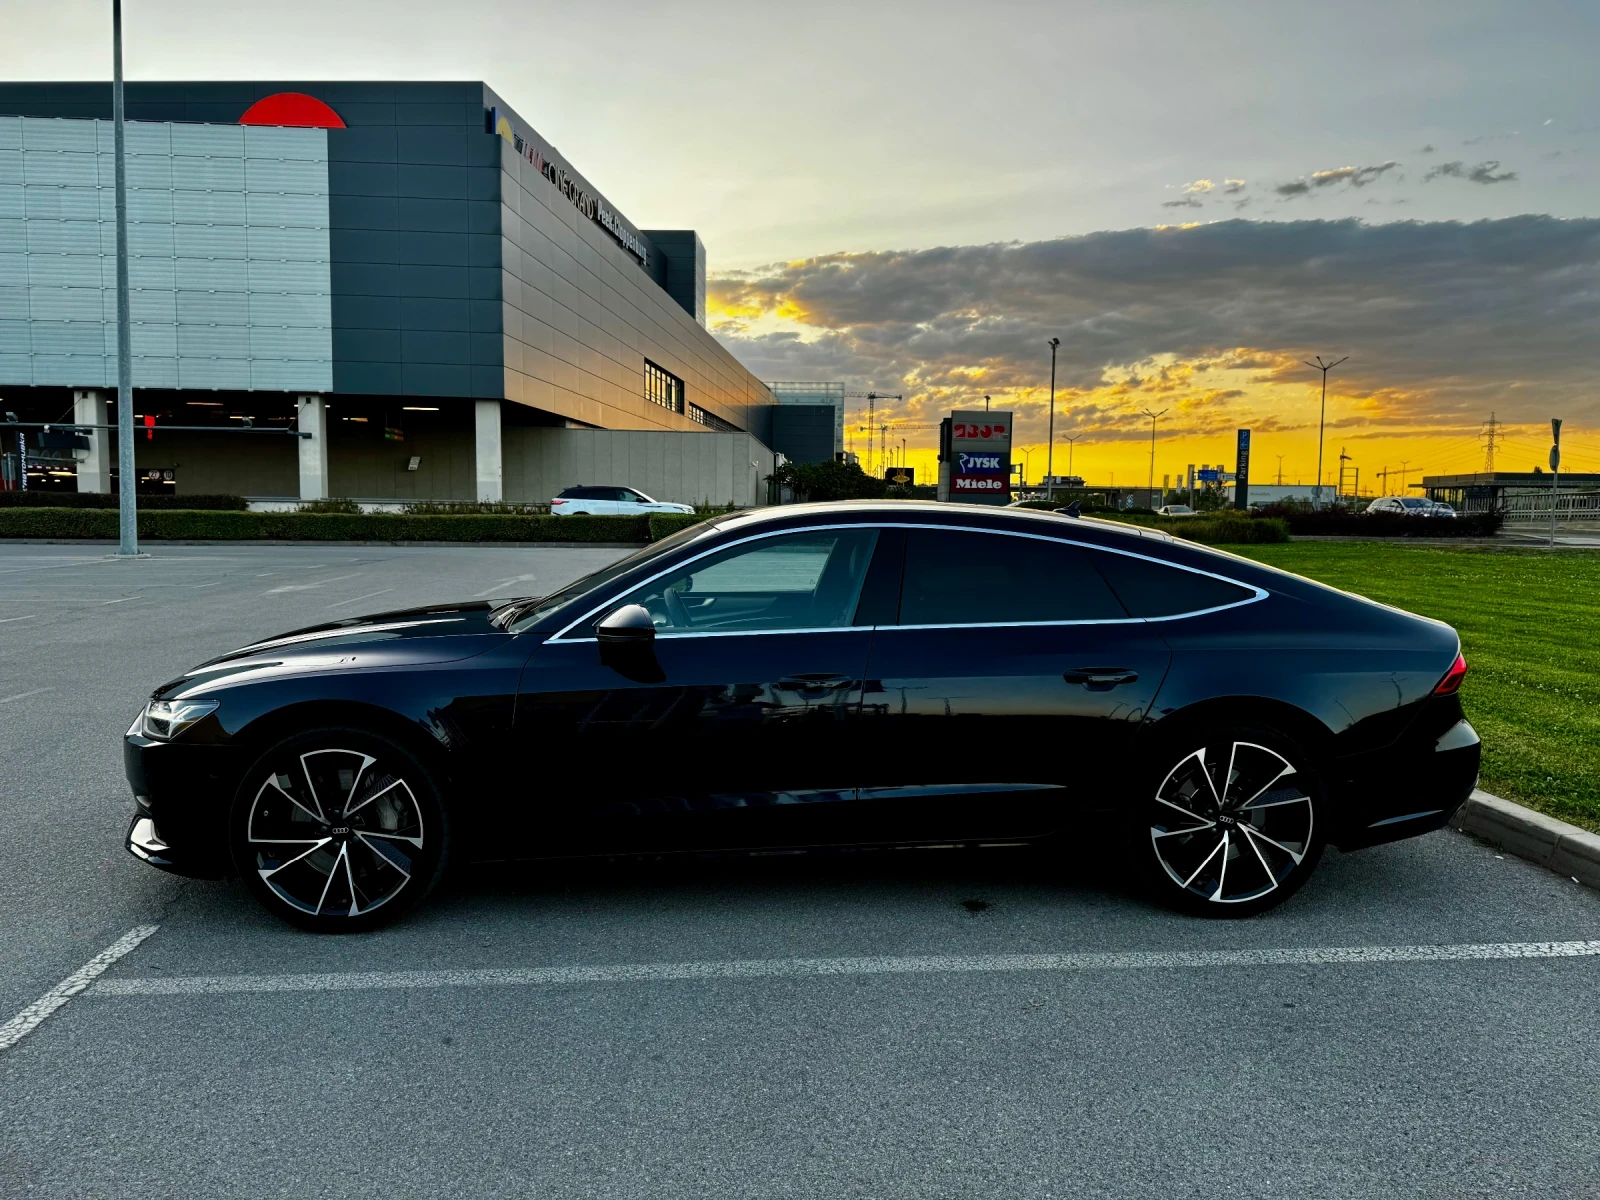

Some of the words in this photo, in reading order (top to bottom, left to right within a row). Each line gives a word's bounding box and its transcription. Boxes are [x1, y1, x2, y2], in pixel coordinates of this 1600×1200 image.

[967, 457, 1000, 469] JYSK
[1239, 450, 1249, 479] Parking
[955, 479, 1002, 489] Miele
